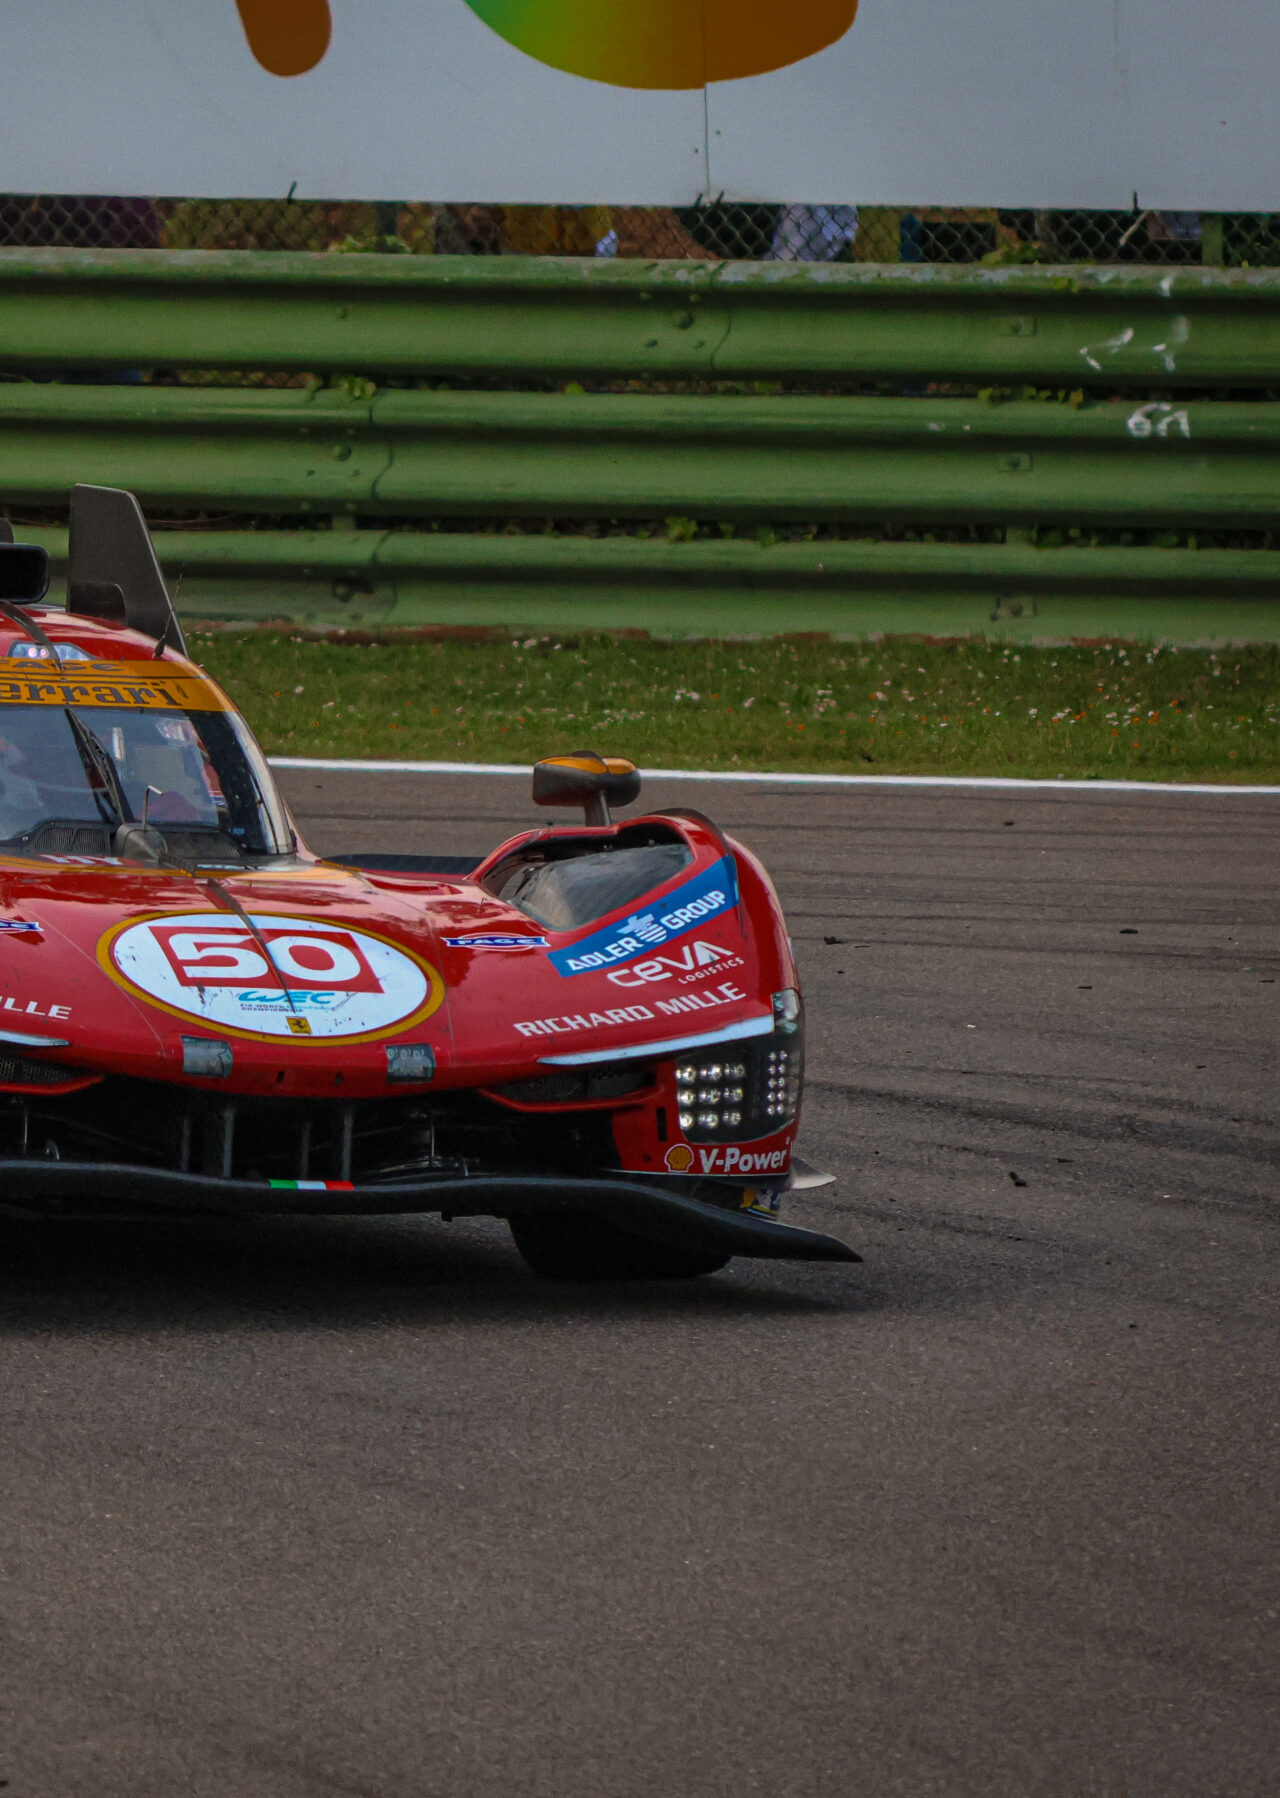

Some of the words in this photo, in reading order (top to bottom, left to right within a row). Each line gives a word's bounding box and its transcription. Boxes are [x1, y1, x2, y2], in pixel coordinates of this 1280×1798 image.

[565, 937, 640, 973] ADLER
[660, 890, 726, 930] GROUP
[168, 933, 361, 983] 50
[678, 957, 744, 984] LOGISTICS
[238, 990, 335, 1004] WEC
[514, 1005, 655, 1036] RICHARD
[655, 982, 746, 1015] MILLE
[700, 1147, 788, 1174] V-Power
